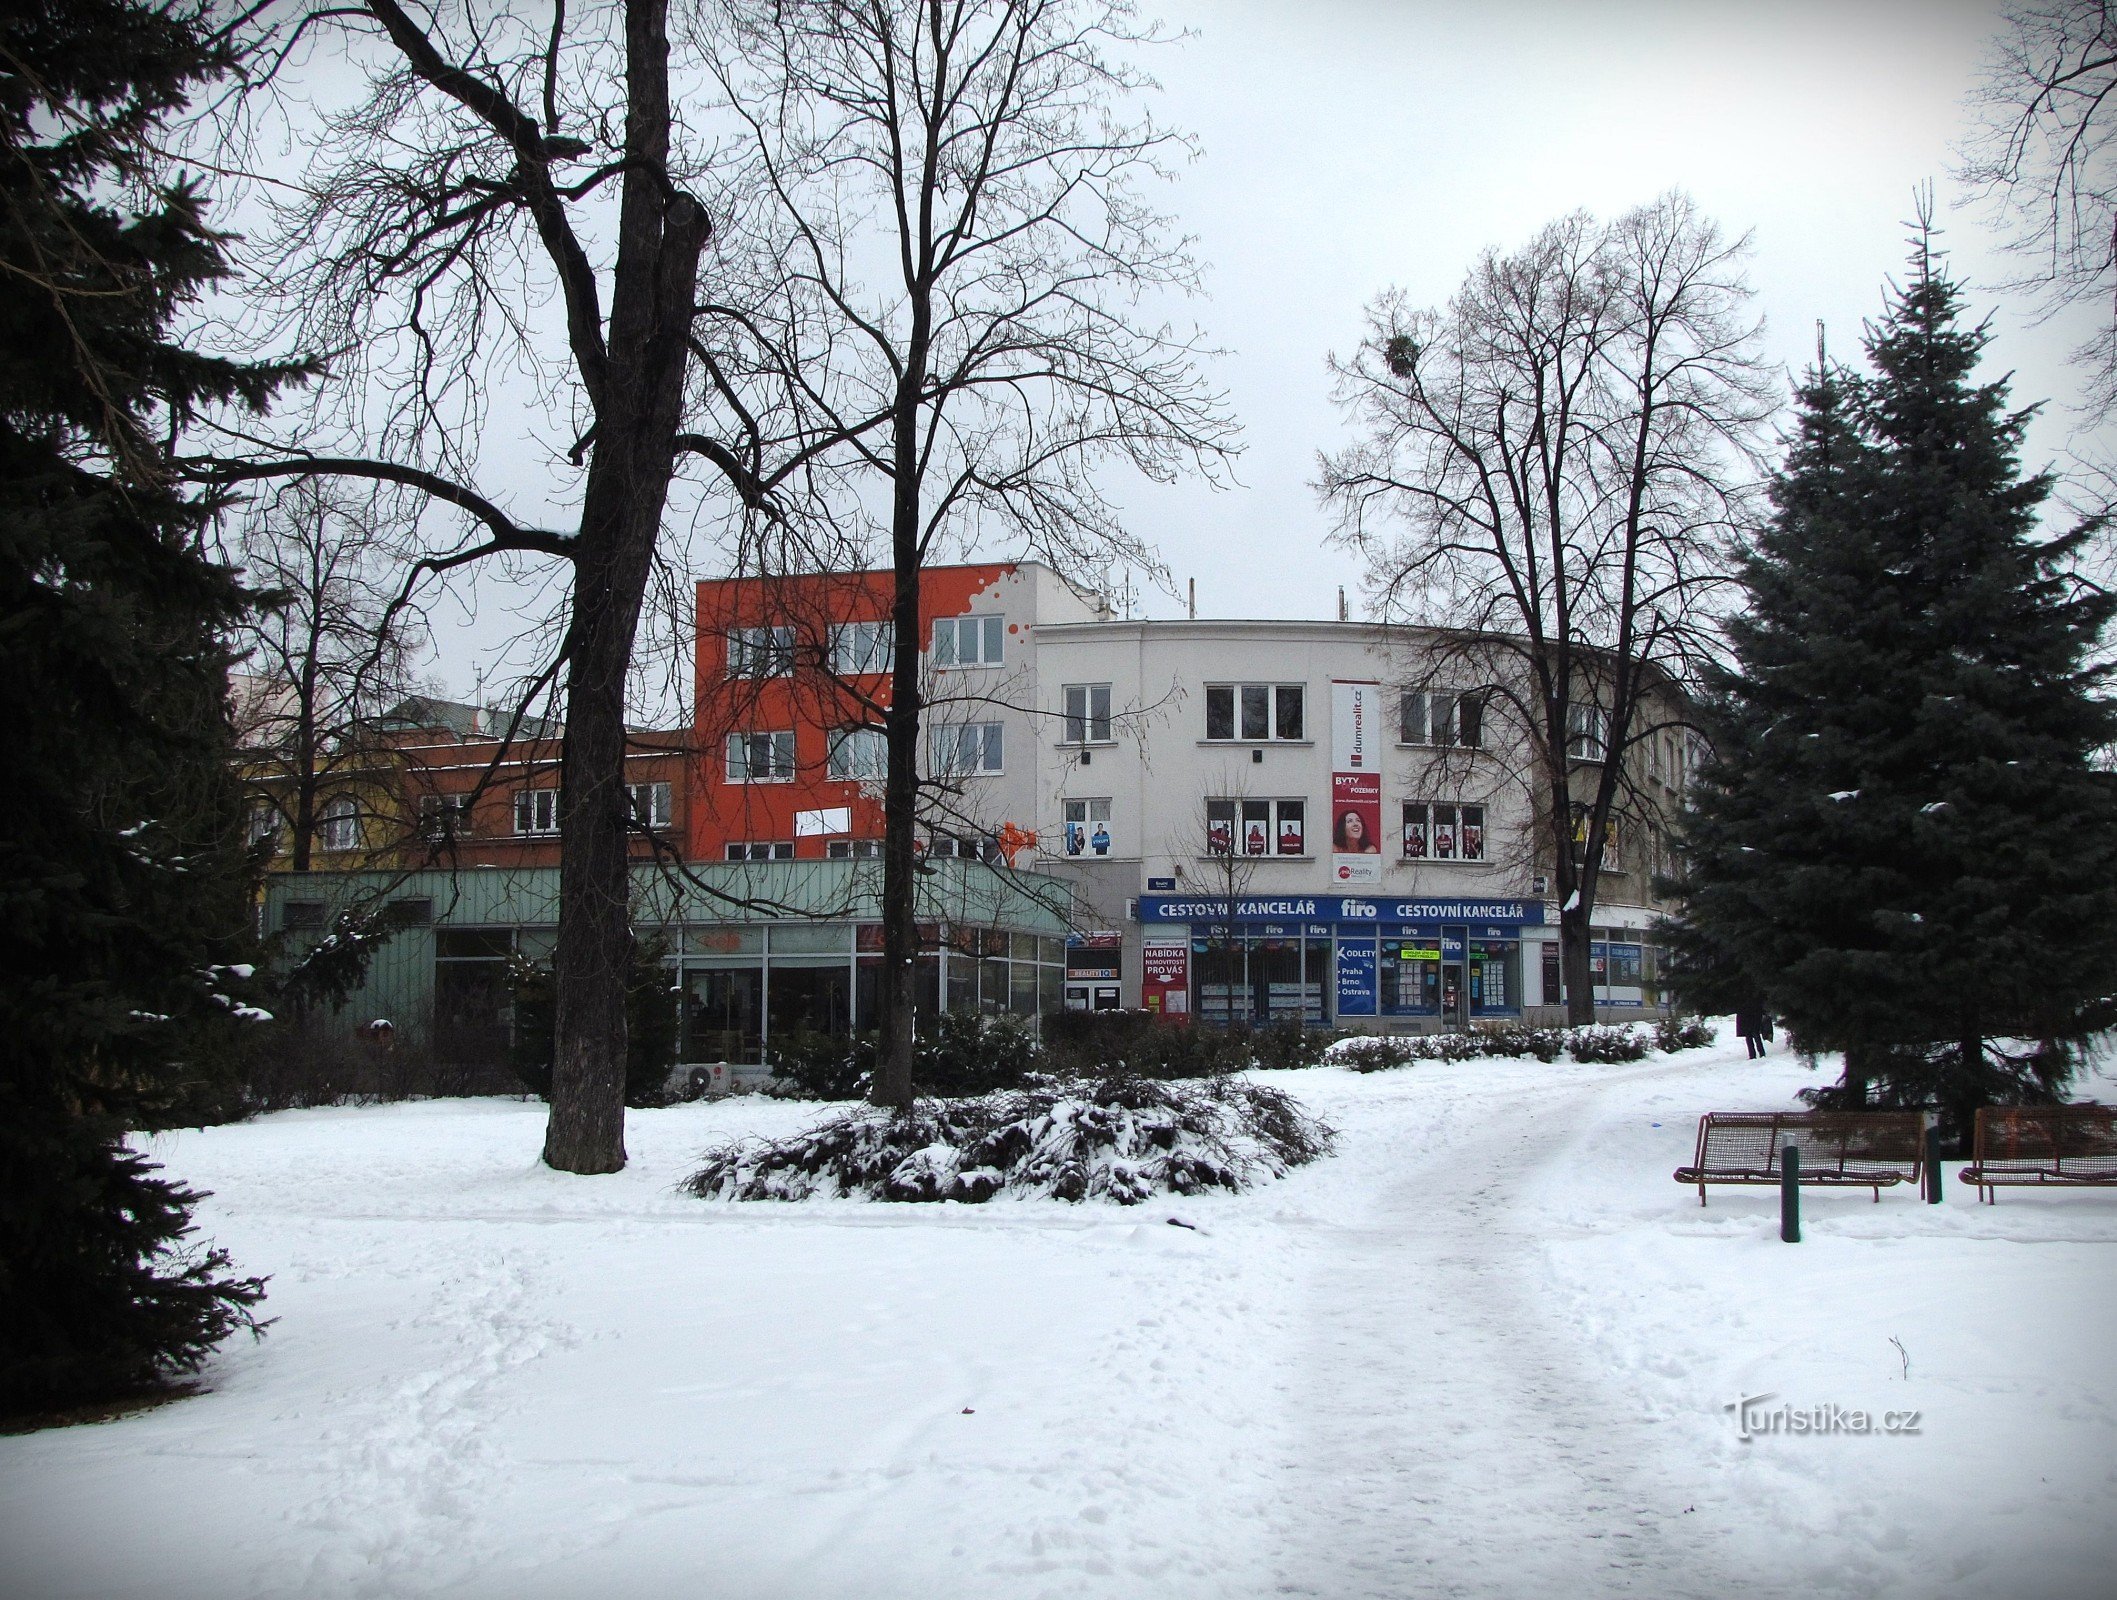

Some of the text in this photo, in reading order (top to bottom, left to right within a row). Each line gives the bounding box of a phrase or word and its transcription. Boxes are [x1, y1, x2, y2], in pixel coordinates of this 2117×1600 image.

[1353, 690, 1362, 753] dumrealit.cz
[1335, 776, 1360, 785] BYTY
[1351, 867, 1373, 877] Reality
[1159, 900, 1316, 917] CESTOVN KANCELÁŘ
[1341, 899, 1377, 917] firo
[1396, 903, 1524, 918] CESTOVNÍ KANCELÁŘ
[1265, 925, 1283, 934] firo
[1309, 925, 1327, 934] firo
[1402, 926, 1418, 935] firo
[1487, 927, 1501, 936] firo
[1145, 949, 1185, 958] NABÍDKA
[1101, 969, 1111, 977] IQ
[1147, 965, 1183, 974] PRO VÁS
[1341, 988, 1371, 996] Ostrava
